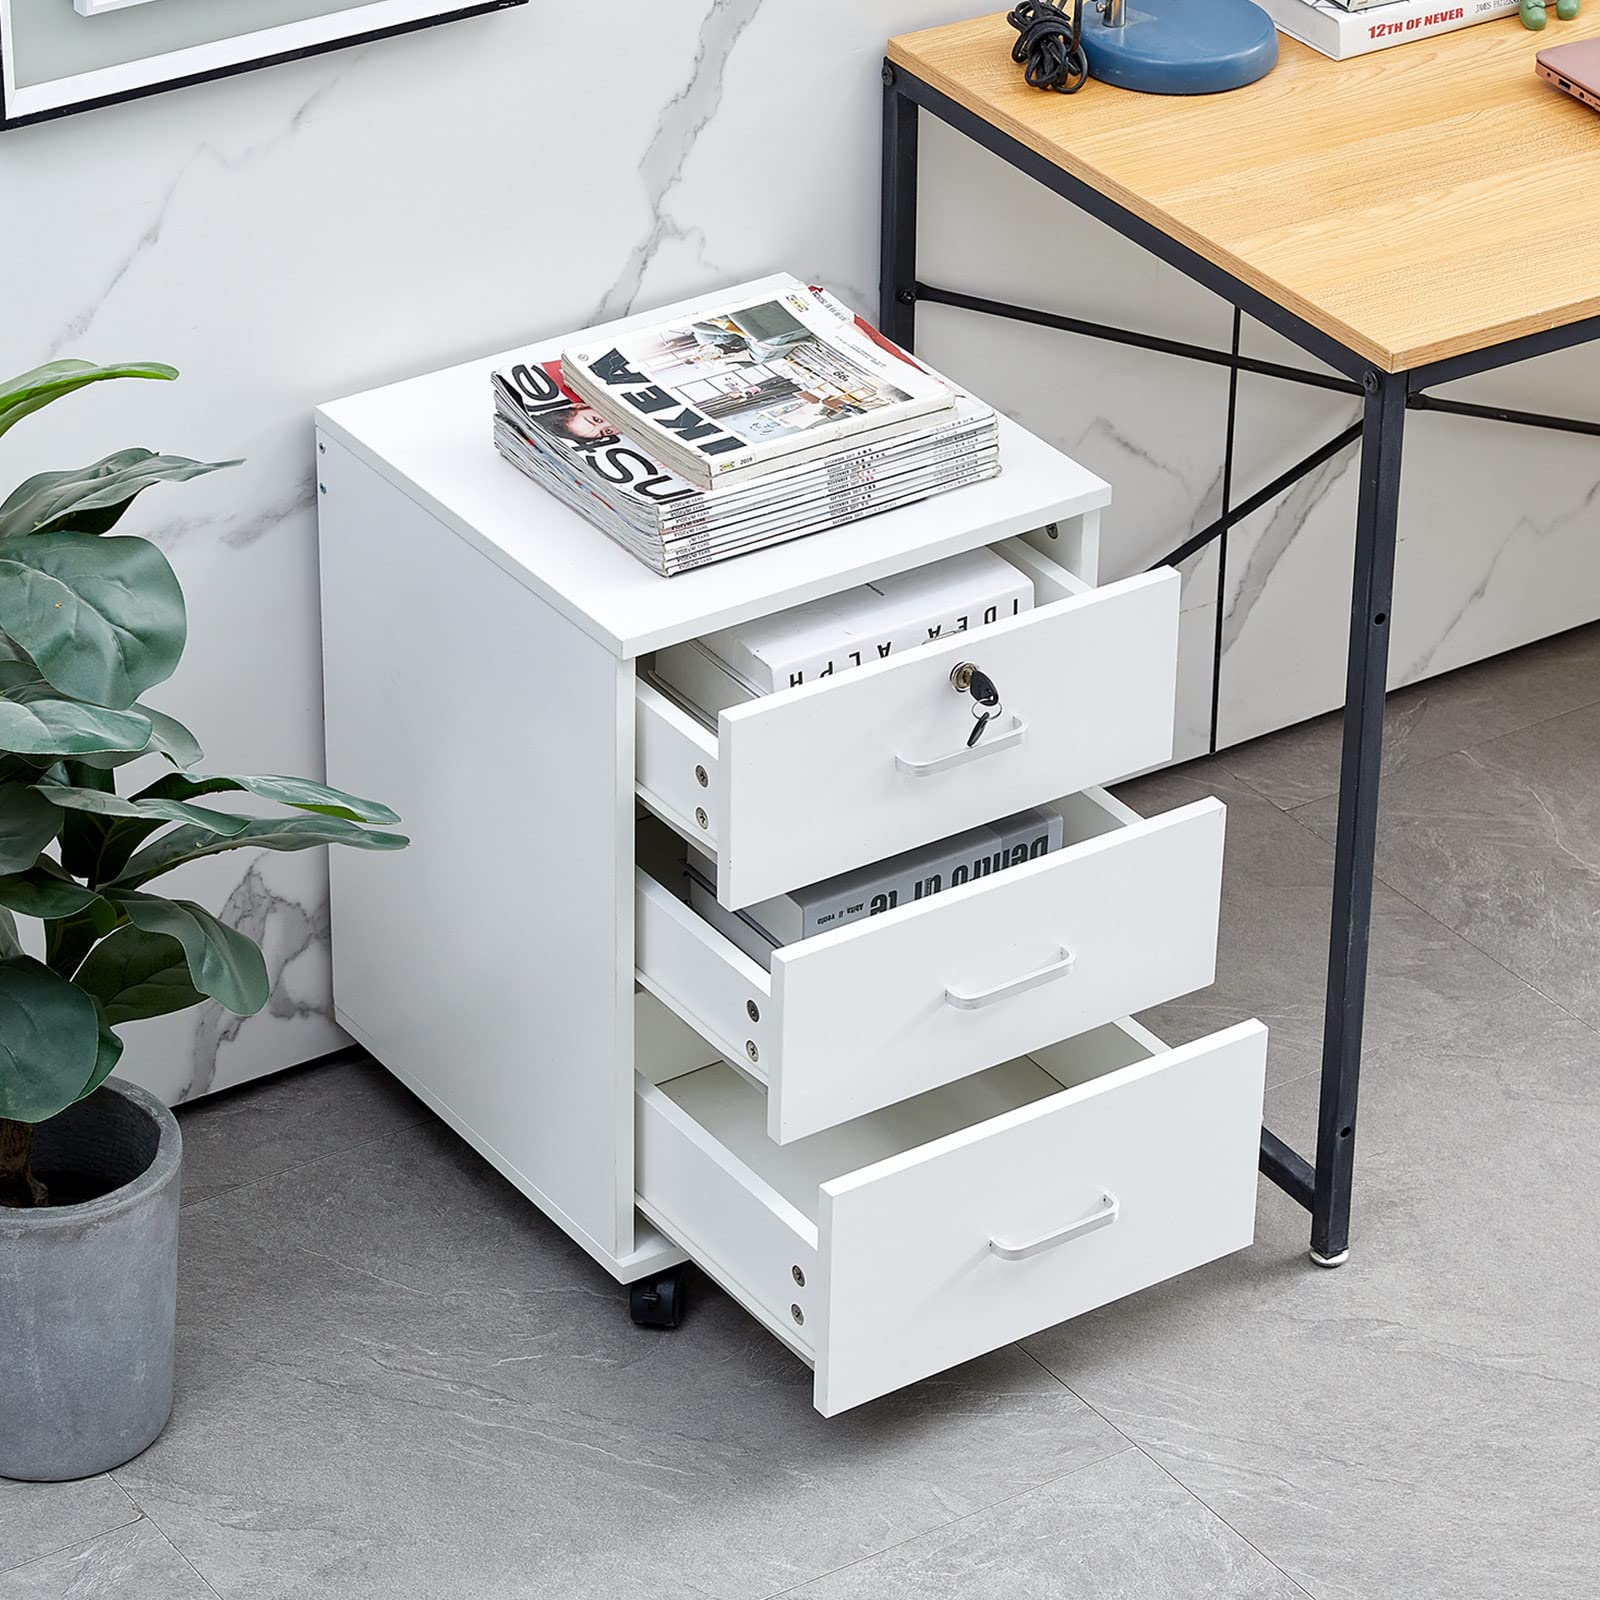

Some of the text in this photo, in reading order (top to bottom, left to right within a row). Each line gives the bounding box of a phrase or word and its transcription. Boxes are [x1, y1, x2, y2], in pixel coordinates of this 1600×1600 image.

[1368, 7, 1464, 39] 12TH OF NEVER
[588, 347, 748, 456] IKEA
[928, 598, 1019, 639] IDEA
